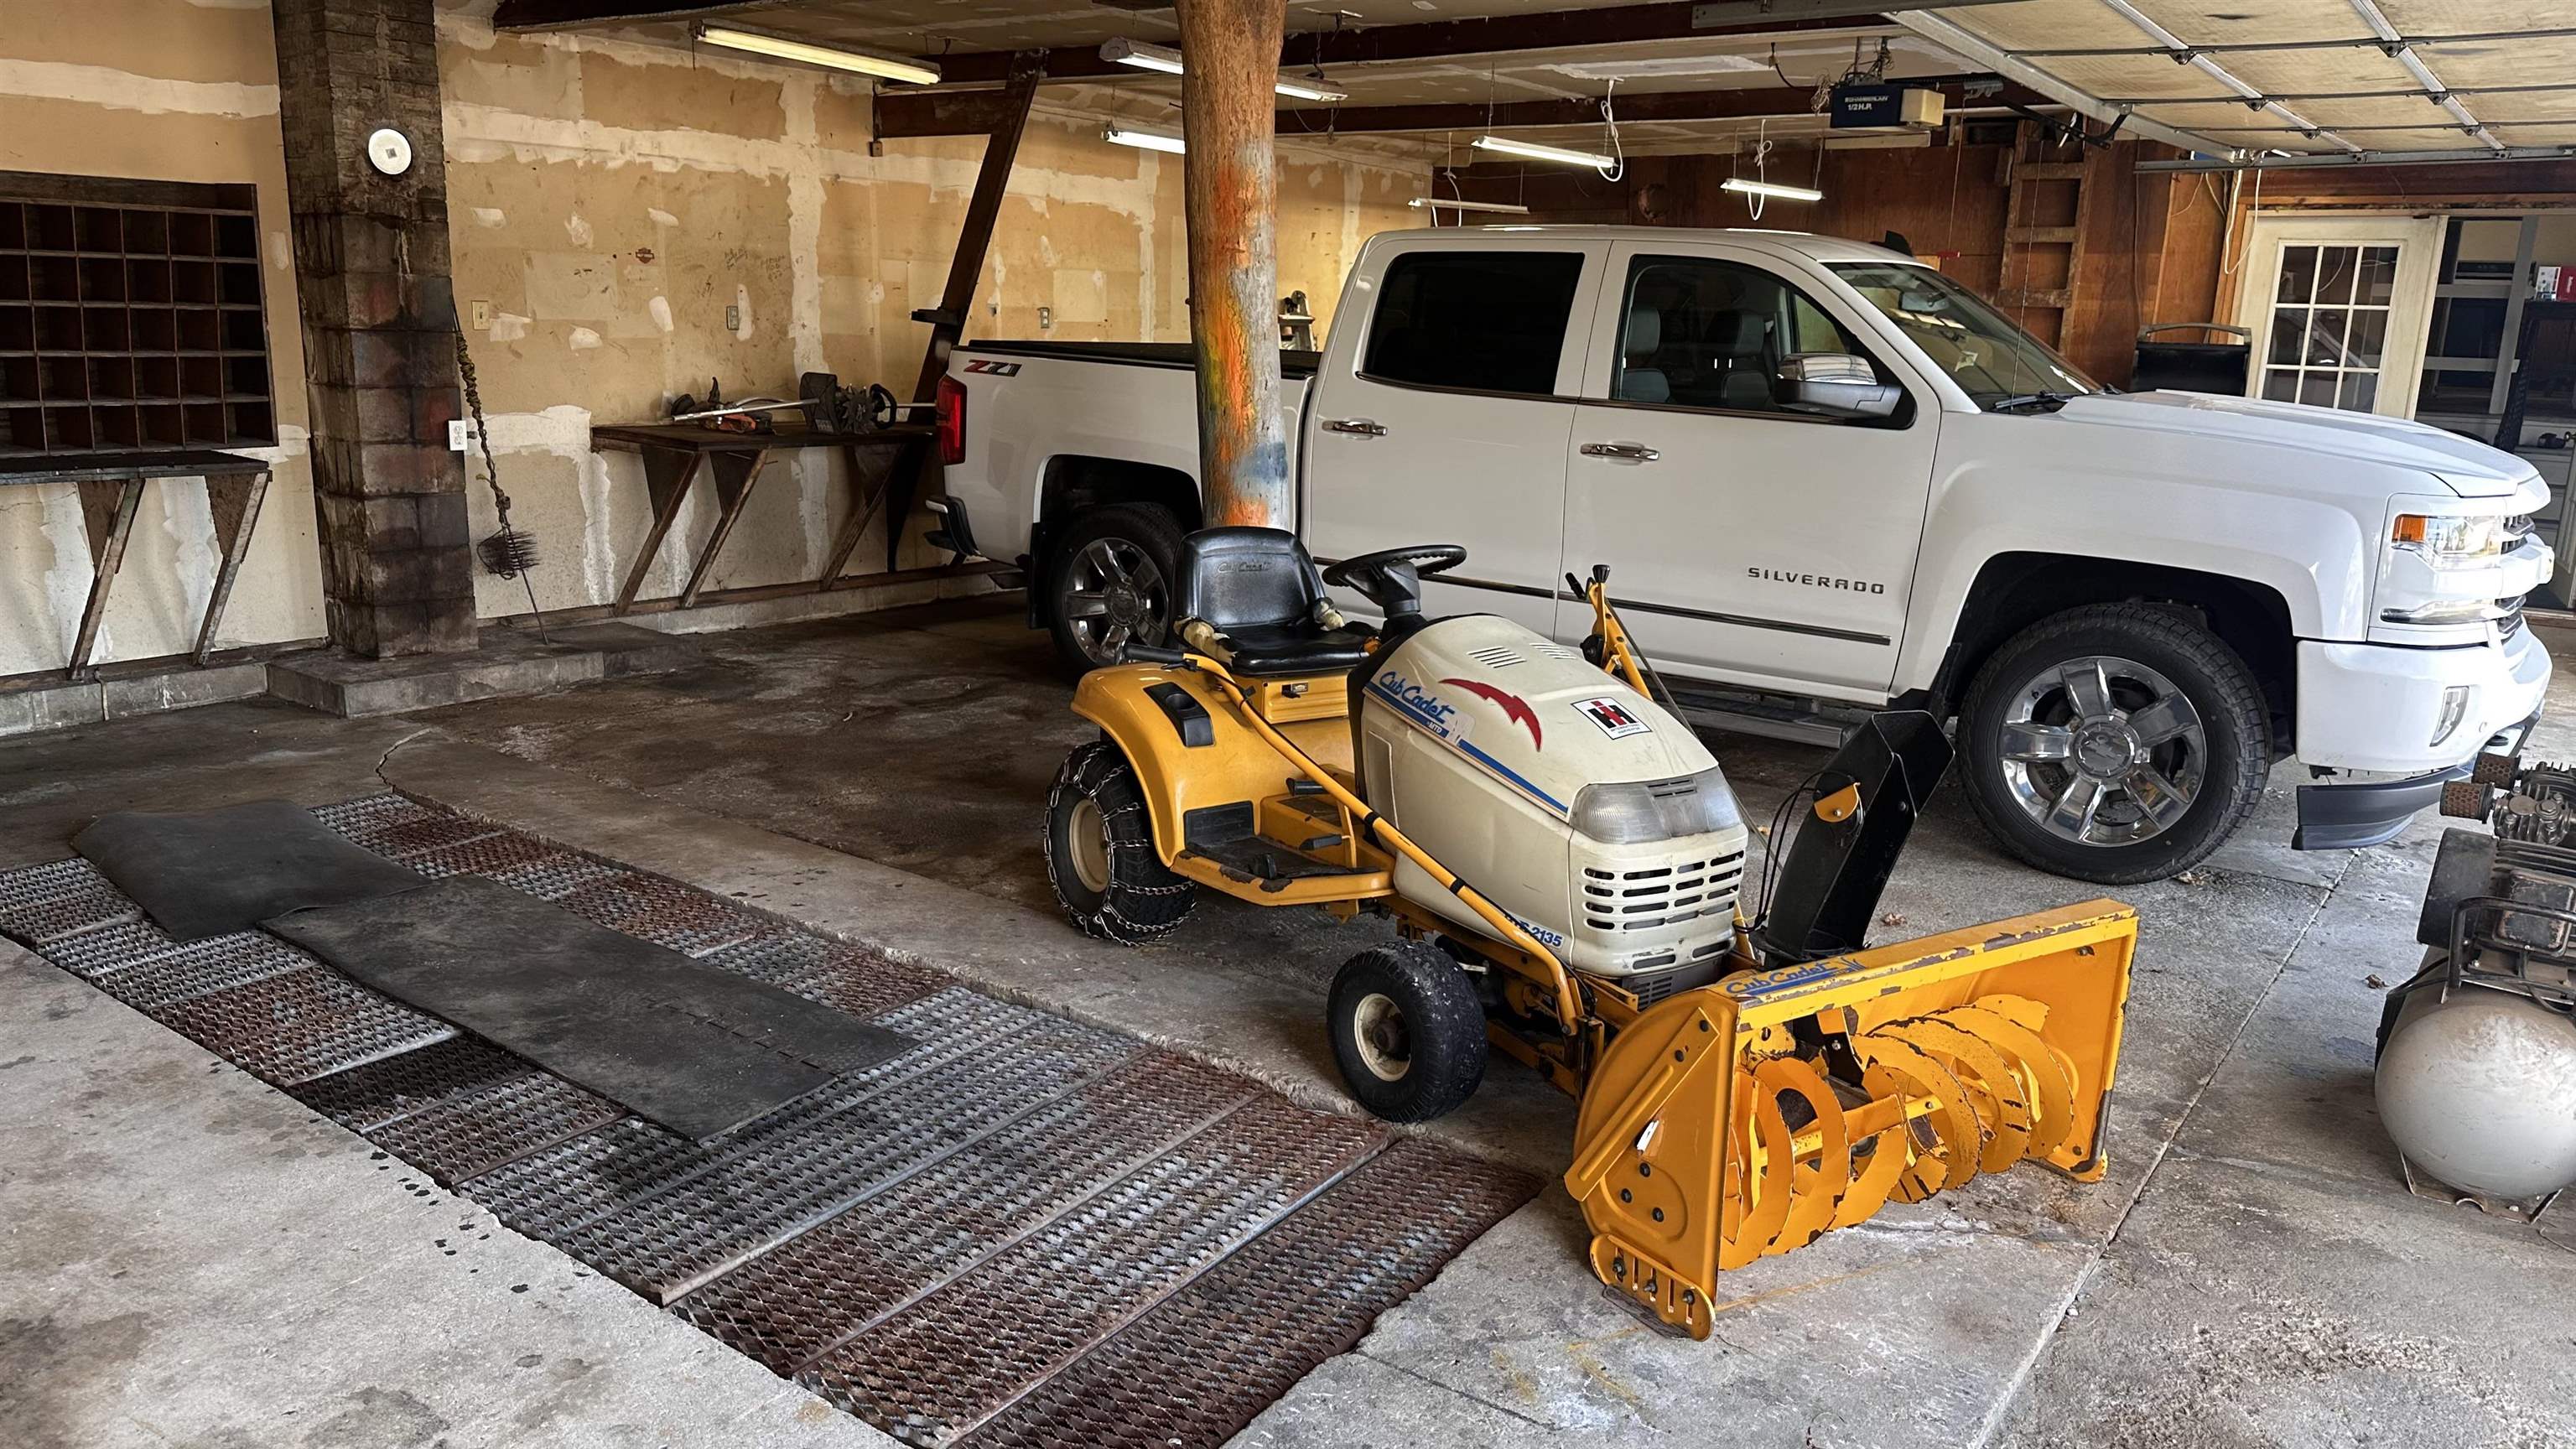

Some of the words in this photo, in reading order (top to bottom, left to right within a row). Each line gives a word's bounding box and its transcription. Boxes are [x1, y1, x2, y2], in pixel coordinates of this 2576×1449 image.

[963, 359, 1022, 377] Z71
[1748, 567, 1885, 595] SILVERADO
[1379, 671, 1406, 695] Cub
[1401, 686, 1455, 724] Cadet
[1428, 721, 1442, 734] MTD
[1531, 927, 1563, 947] 2135
[1726, 978, 1772, 994] Cub
[1769, 962, 1838, 983] Cadet
